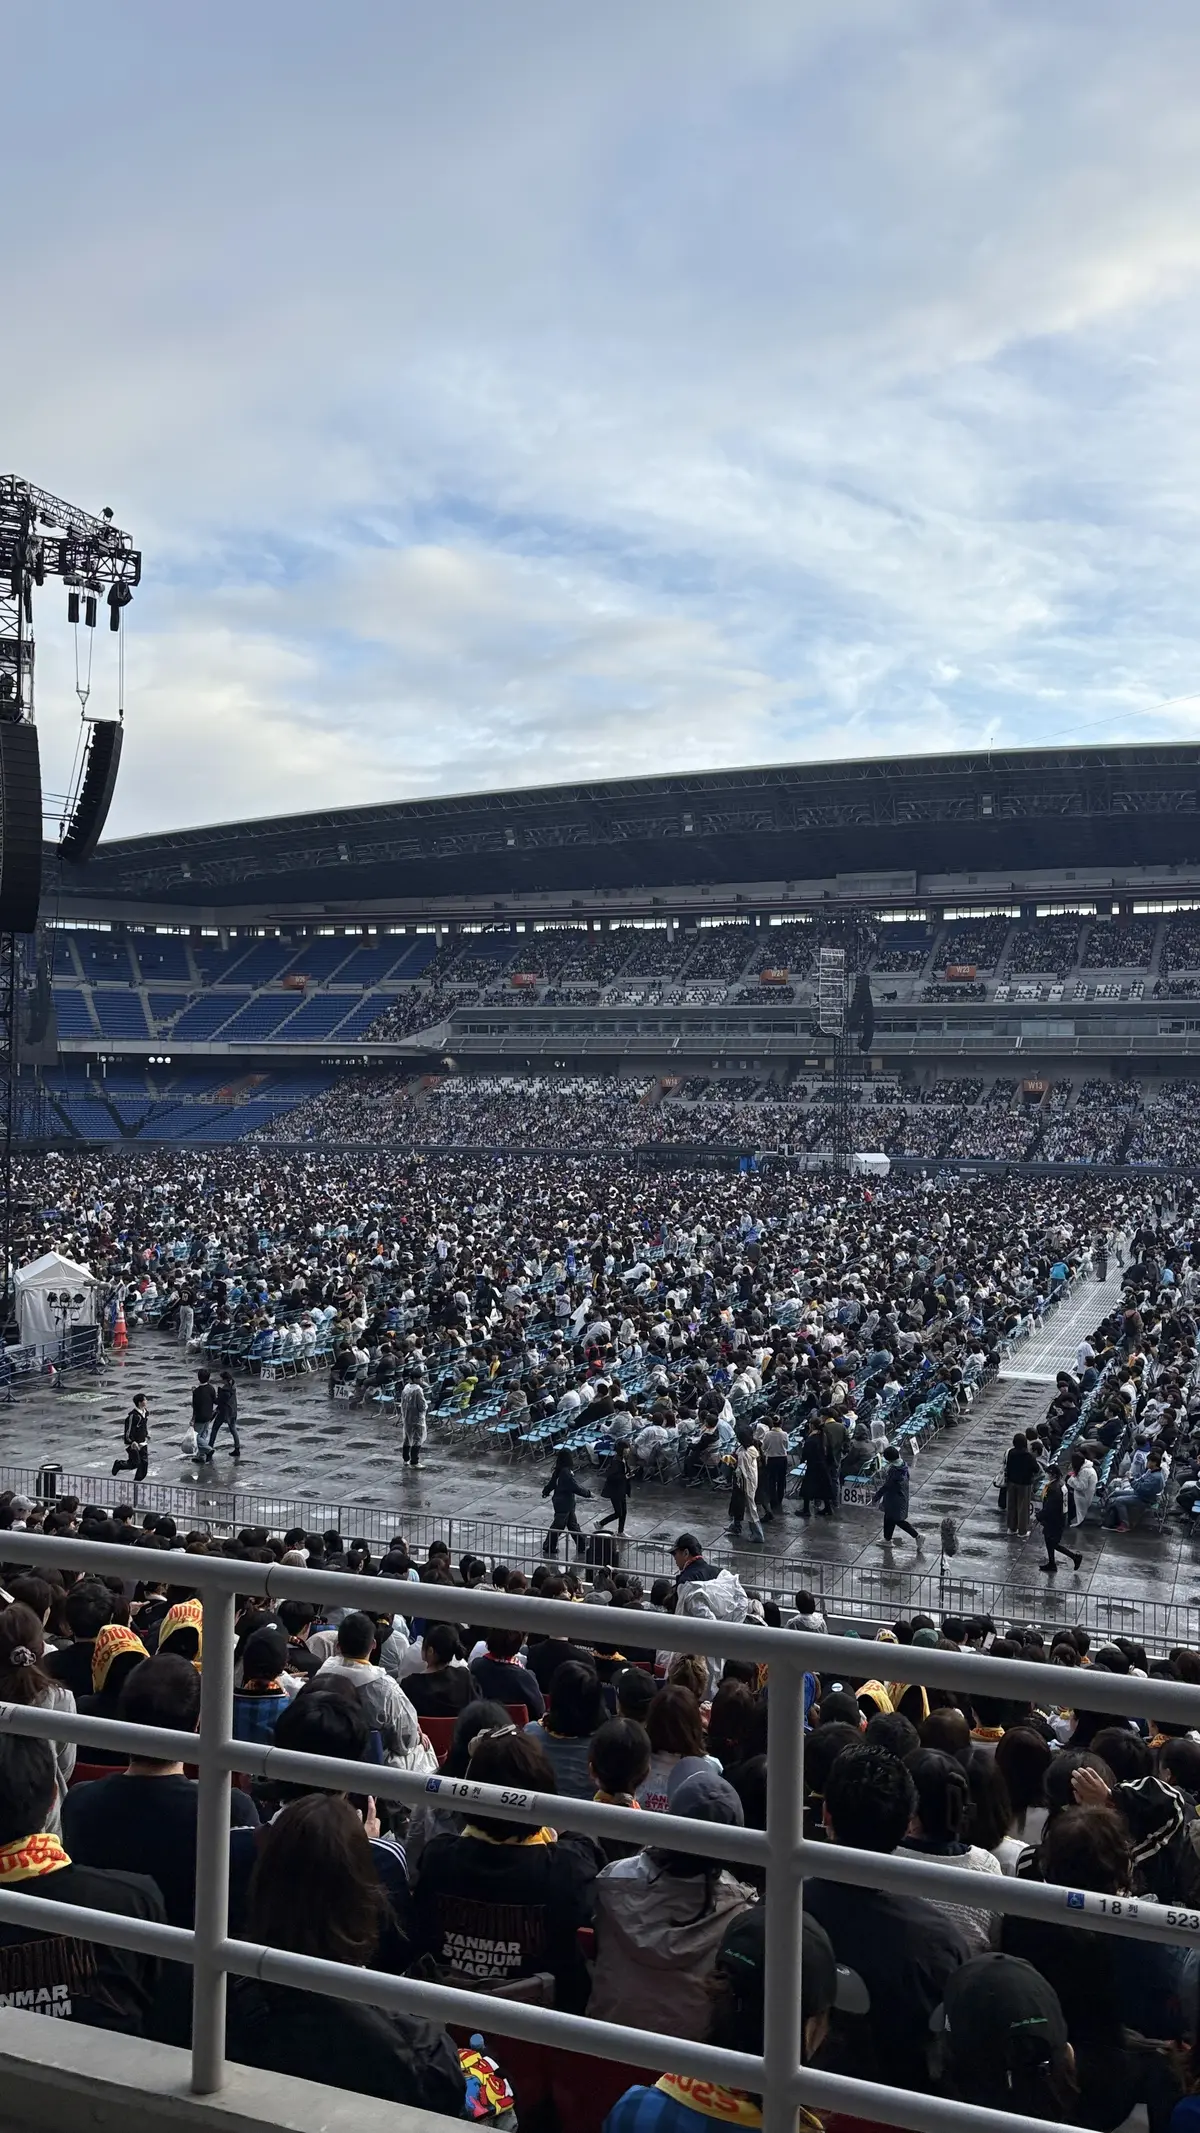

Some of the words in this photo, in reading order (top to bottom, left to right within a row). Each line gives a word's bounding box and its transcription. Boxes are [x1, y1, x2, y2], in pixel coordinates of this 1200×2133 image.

[1027, 1081, 1043, 1090] W13
[451, 1783, 469, 1797] 18
[500, 1791, 528, 1808] 522
[1099, 1899, 1122, 1915] 18
[1166, 1911, 1200, 1929] 523
[445, 1931, 521, 1954] YANMAR
[442, 1943, 522, 1967] STADIUM
[451, 1958, 508, 1977] NAGAI
[0, 1984, 69, 2008] NMAR
